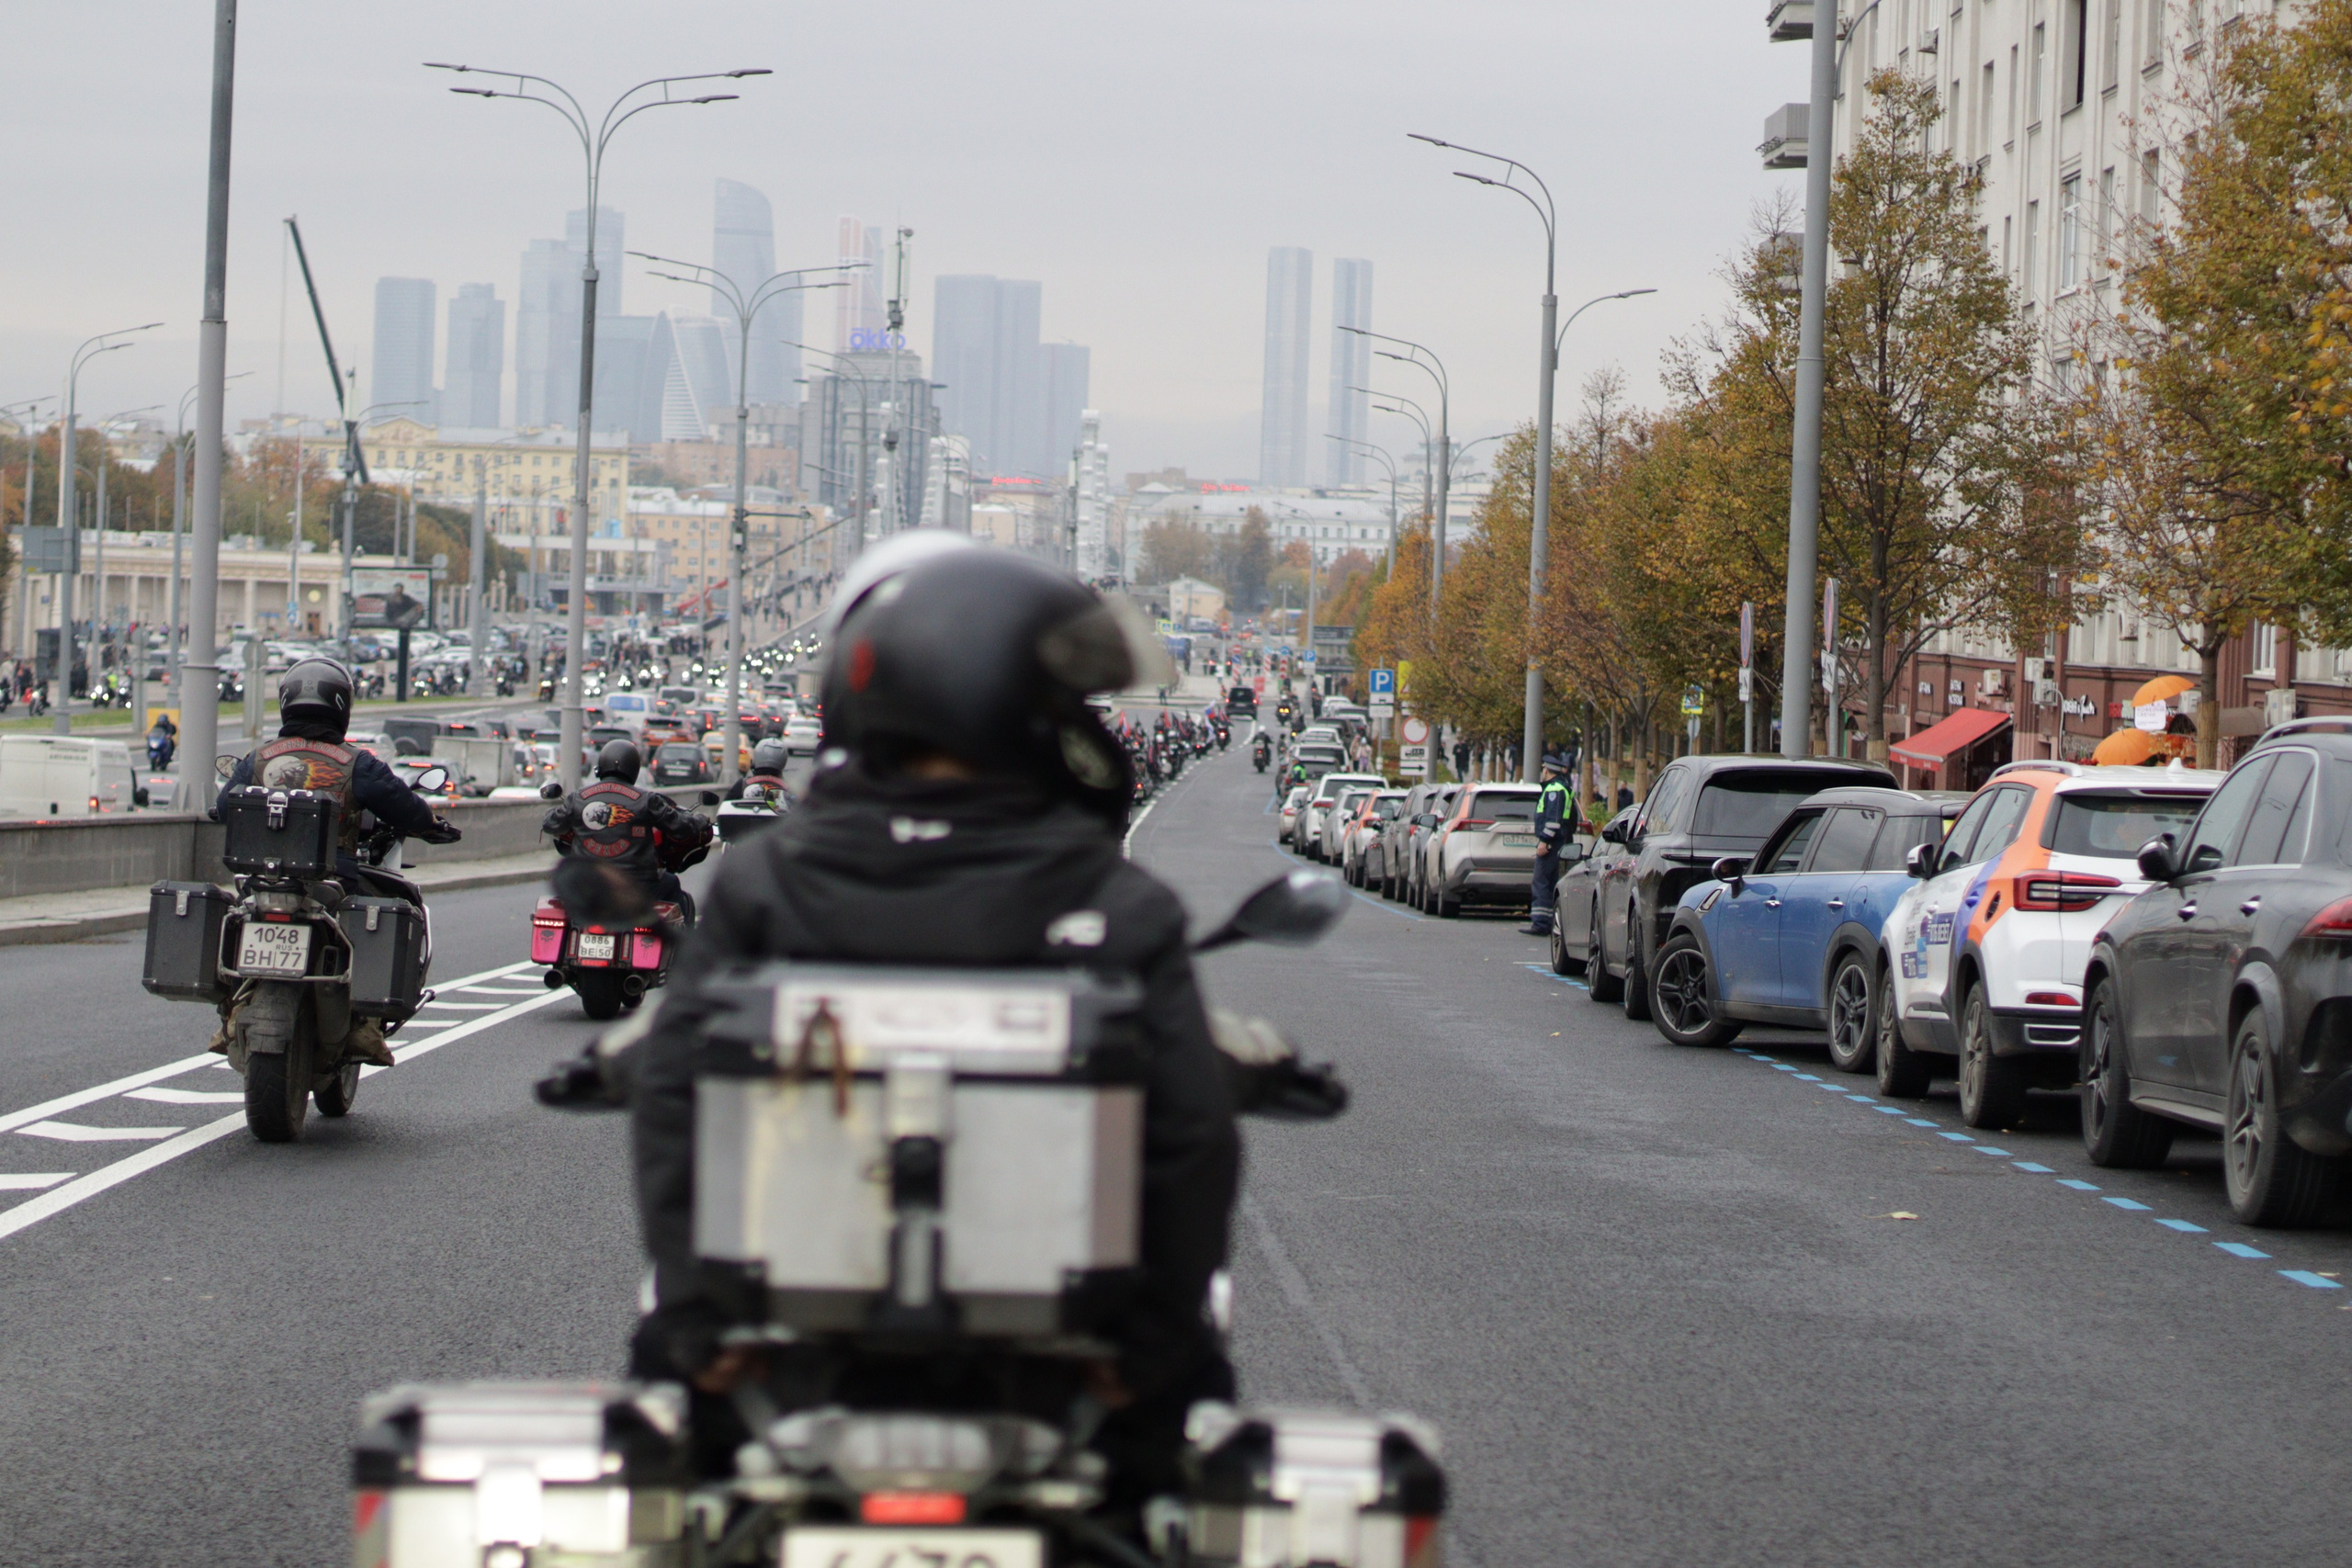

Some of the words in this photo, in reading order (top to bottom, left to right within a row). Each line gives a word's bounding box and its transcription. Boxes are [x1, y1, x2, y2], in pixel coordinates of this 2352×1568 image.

[1375, 671, 1390, 691] P
[254, 928, 299, 943] 1048
[584, 936, 610, 944] 0886
[279, 952, 302, 967] 77
[598, 948, 610, 957] 50
